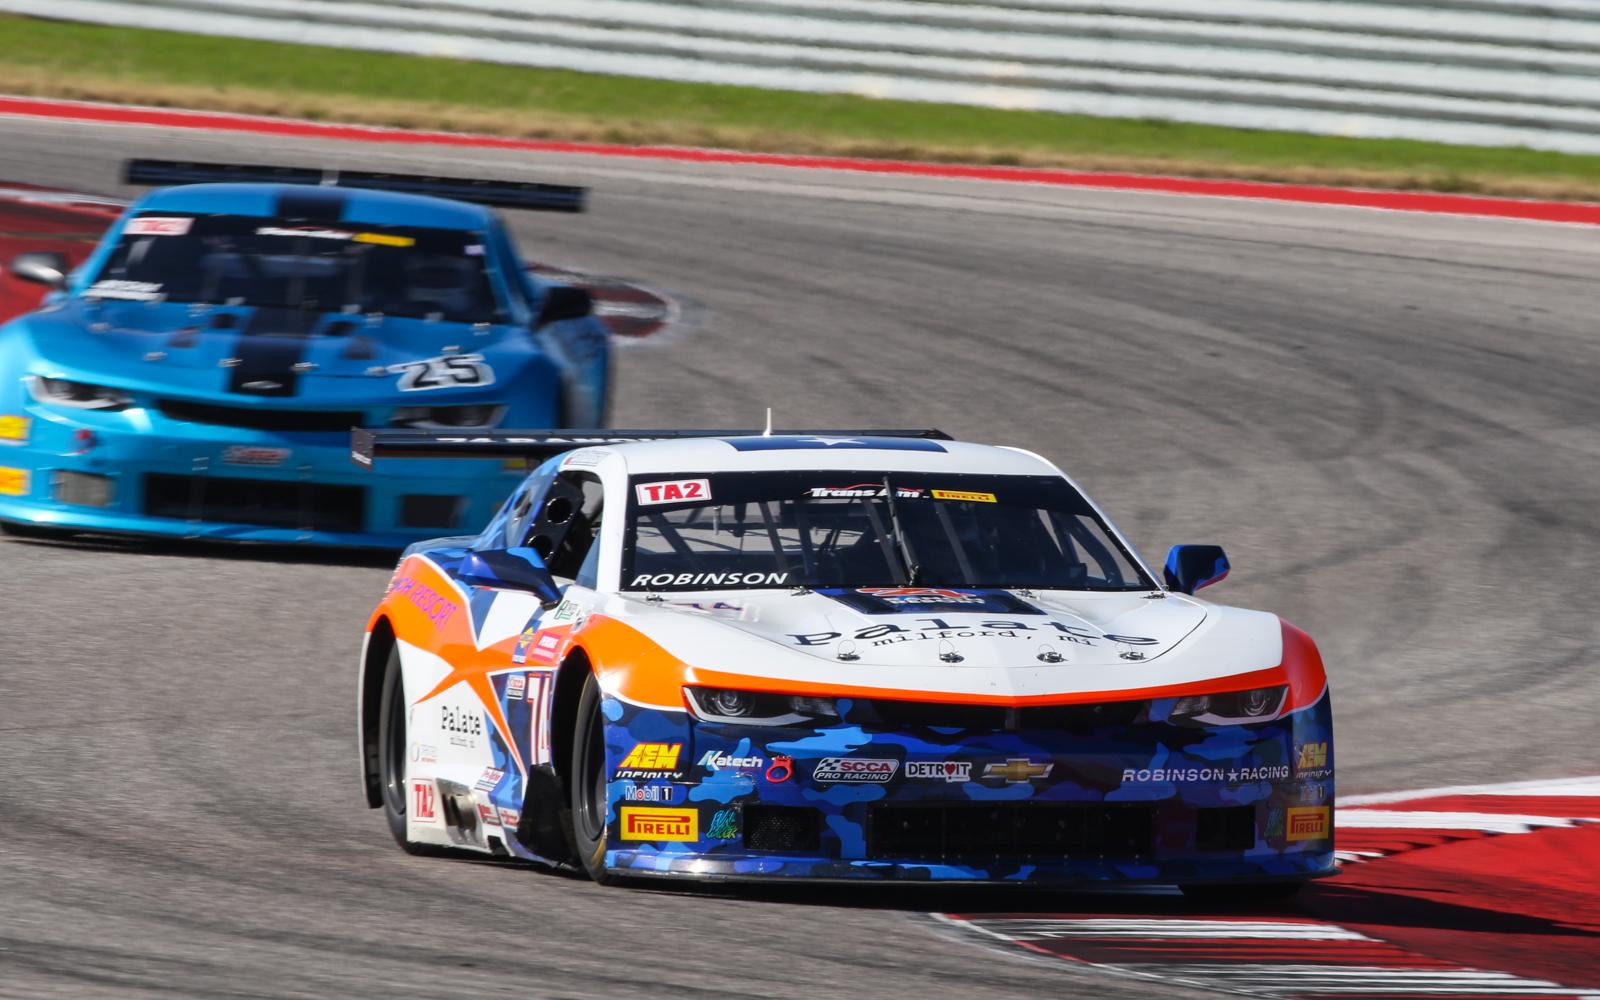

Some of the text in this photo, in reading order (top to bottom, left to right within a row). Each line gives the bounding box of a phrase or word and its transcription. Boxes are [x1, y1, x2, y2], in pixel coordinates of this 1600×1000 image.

[396, 355, 487, 390] 25
[645, 482, 702, 500] TA2
[811, 486, 876, 497] Trans
[938, 491, 990, 500] PIRELLI
[630, 572, 788, 588] ROBINSON
[441, 705, 481, 735] Palate
[619, 743, 682, 769] AEM
[697, 751, 763, 770] Katech
[840, 761, 891, 772] SCCA
[1122, 765, 1289, 782] ROBINSON RACING
[816, 772, 889, 781] PRO RACING
[415, 784, 434, 818] TA2
[625, 785, 673, 800] Mobil 1
[627, 813, 691, 836] PIRELLI
[1291, 812, 1325, 834] PIRELLI
